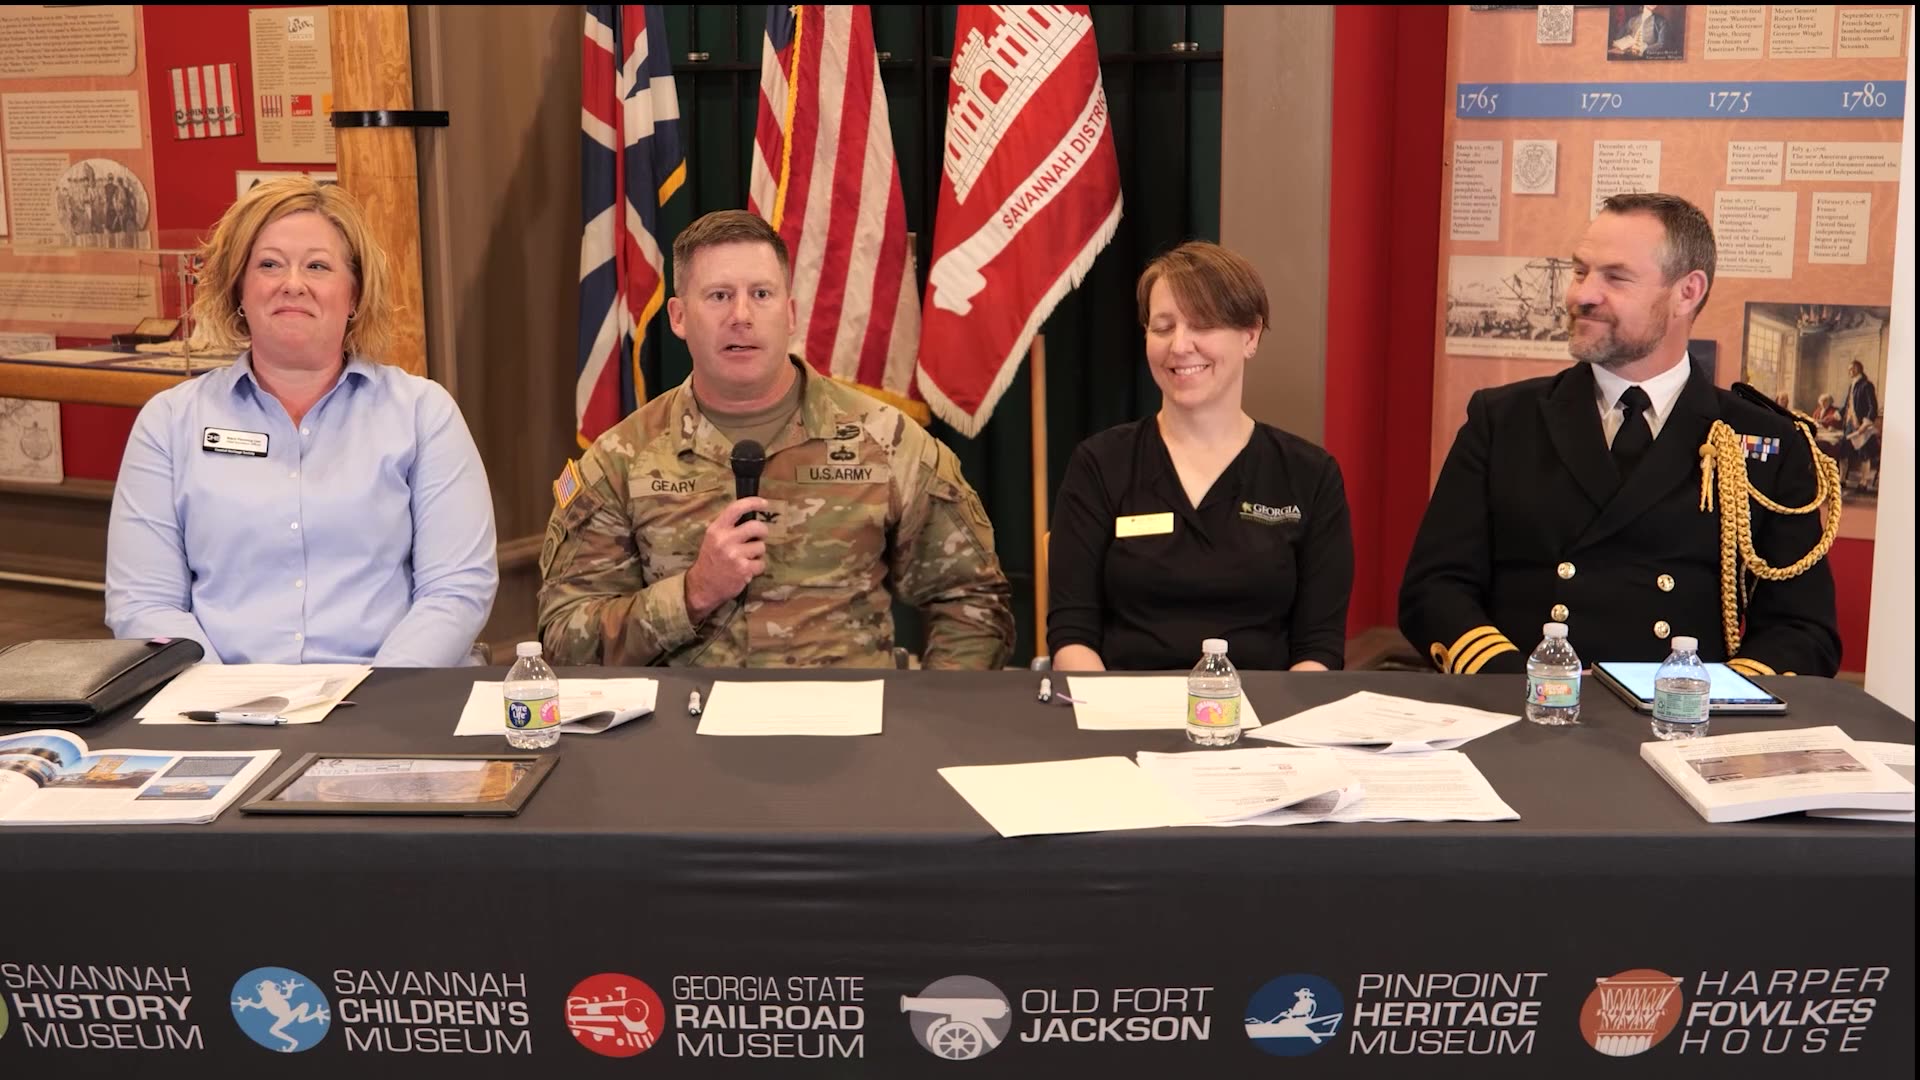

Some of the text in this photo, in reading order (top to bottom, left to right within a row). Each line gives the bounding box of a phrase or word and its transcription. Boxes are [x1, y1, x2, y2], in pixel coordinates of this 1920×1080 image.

[1459, 82, 1887, 113] 1765 1770 1775 1780
[1002, 90, 1106, 230] SAVANNAH DISTRIC
[651, 479, 696, 493] GEARY
[1253, 503, 1301, 517] GEORGIA
[511, 703, 528, 712] Pure
[512, 710, 527, 720] Life
[2, 964, 190, 991] SAVANNAH
[334, 970, 525, 997] SAVANNAH
[673, 976, 863, 1001] GEORGIA STATE
[1358, 973, 1547, 997] PINPOINT
[1697, 967, 1889, 995] HARPER
[13, 993, 191, 1020] HISTORY
[339, 999, 528, 1025] CHILDREN'S
[1022, 988, 1213, 1013] OLD FORT
[1687, 999, 1876, 1026] FOWLKES
[676, 1005, 864, 1029] RAILROAD
[1354, 1002, 1541, 1026] HERITAGE
[23, 1023, 203, 1049] MUSEUM
[345, 1027, 531, 1053] MUSEUM
[1021, 1016, 1210, 1042] JACKSON
[1350, 1030, 1535, 1054] MUSEUM
[1680, 1027, 1866, 1053] HOUSE
[678, 1033, 863, 1058] MUSEUM
